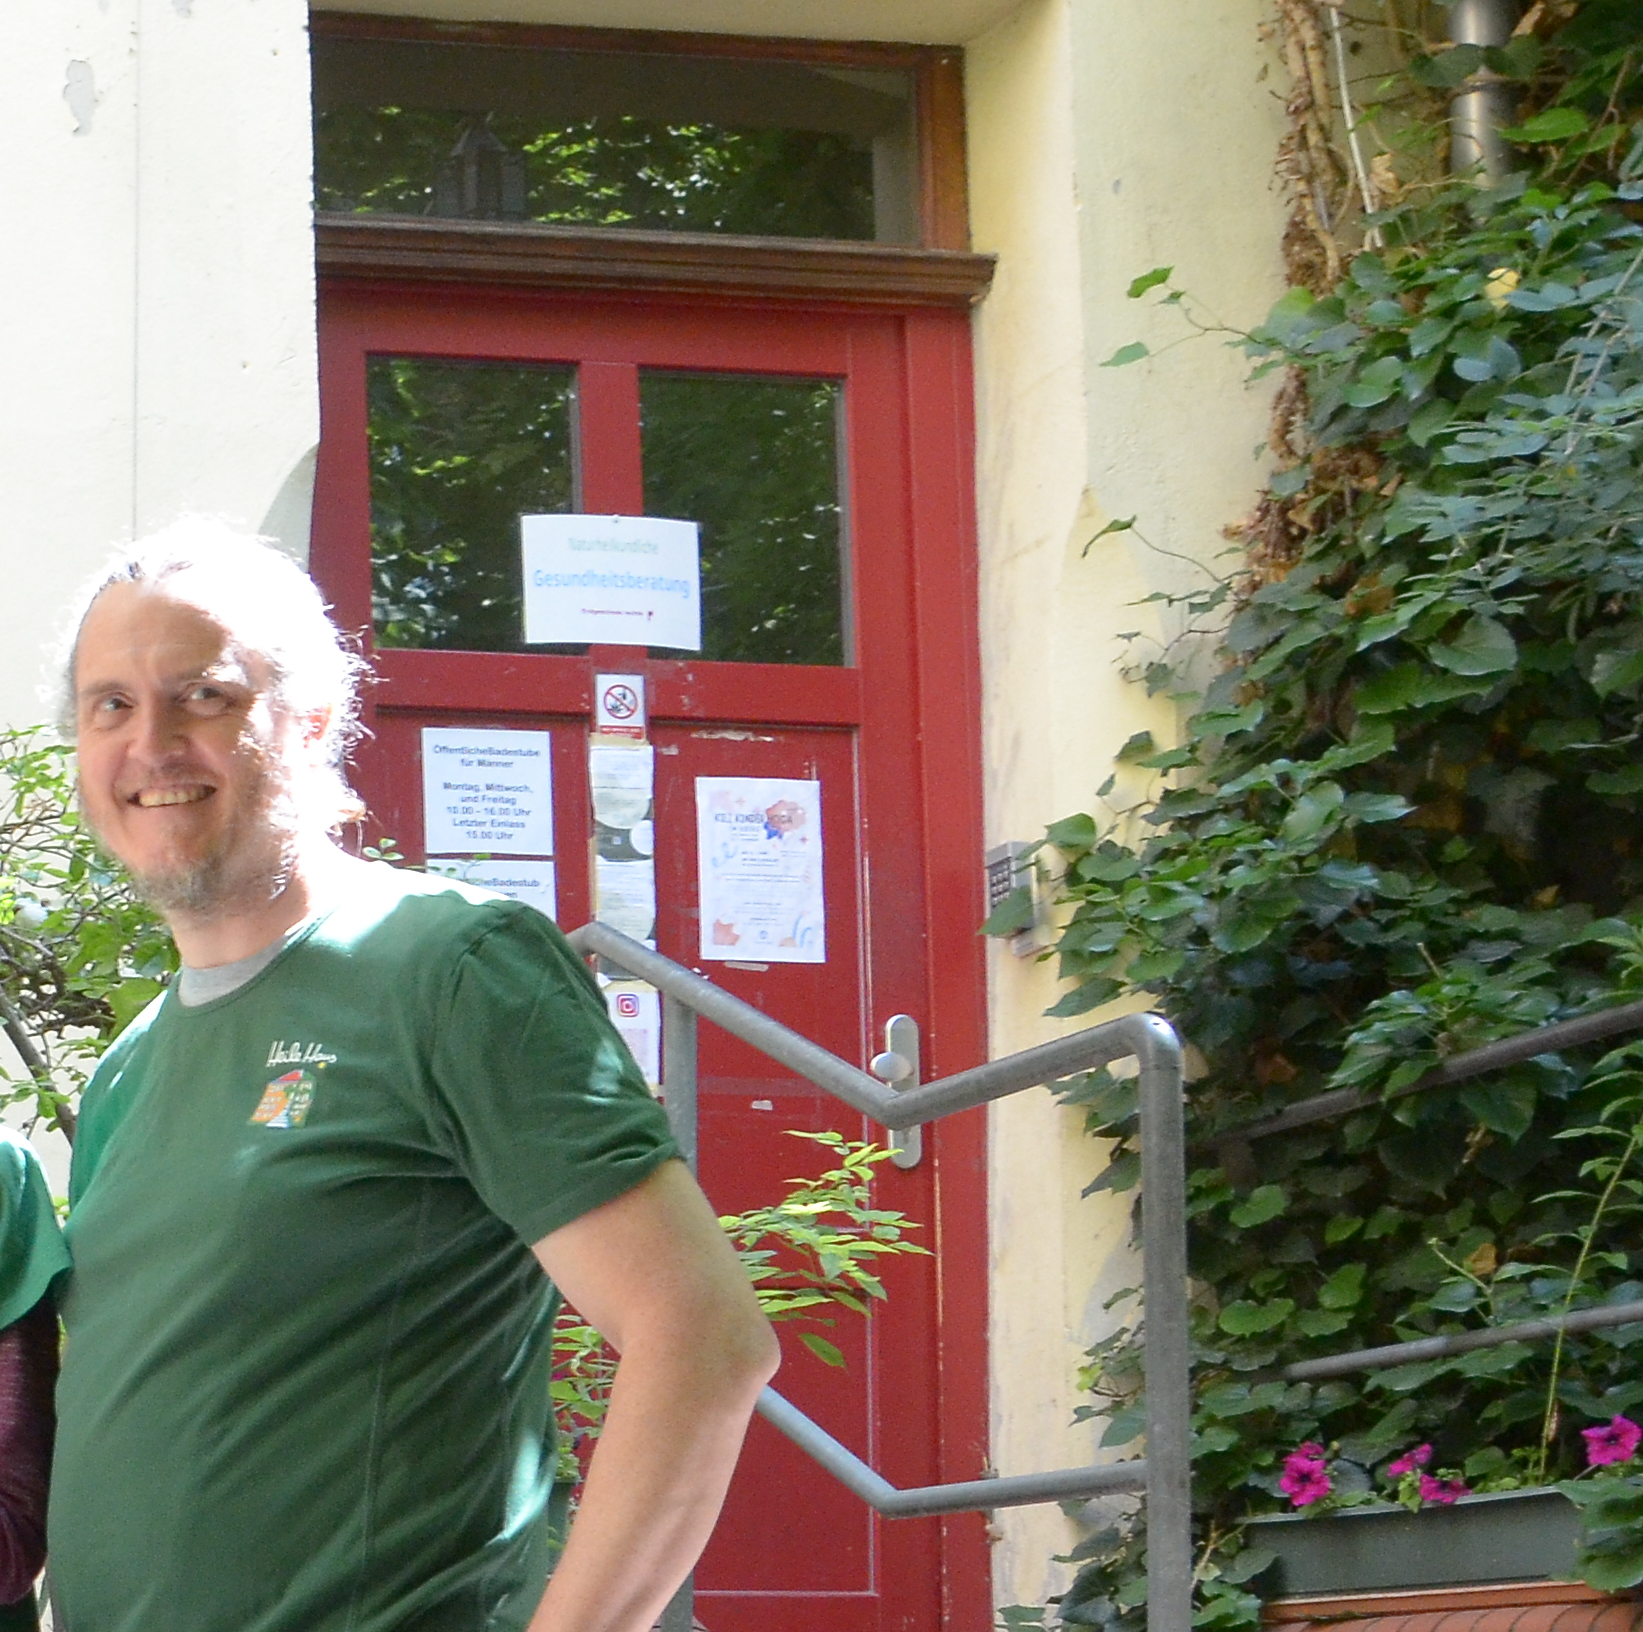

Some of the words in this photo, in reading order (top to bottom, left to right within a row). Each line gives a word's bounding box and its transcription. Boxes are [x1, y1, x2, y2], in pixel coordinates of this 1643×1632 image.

[532, 568, 690, 599] Gesundheitsberatung
[482, 794, 517, 805] Freitag
[266, 1041, 302, 1067] Heile
[302, 1043, 337, 1063] Haus
